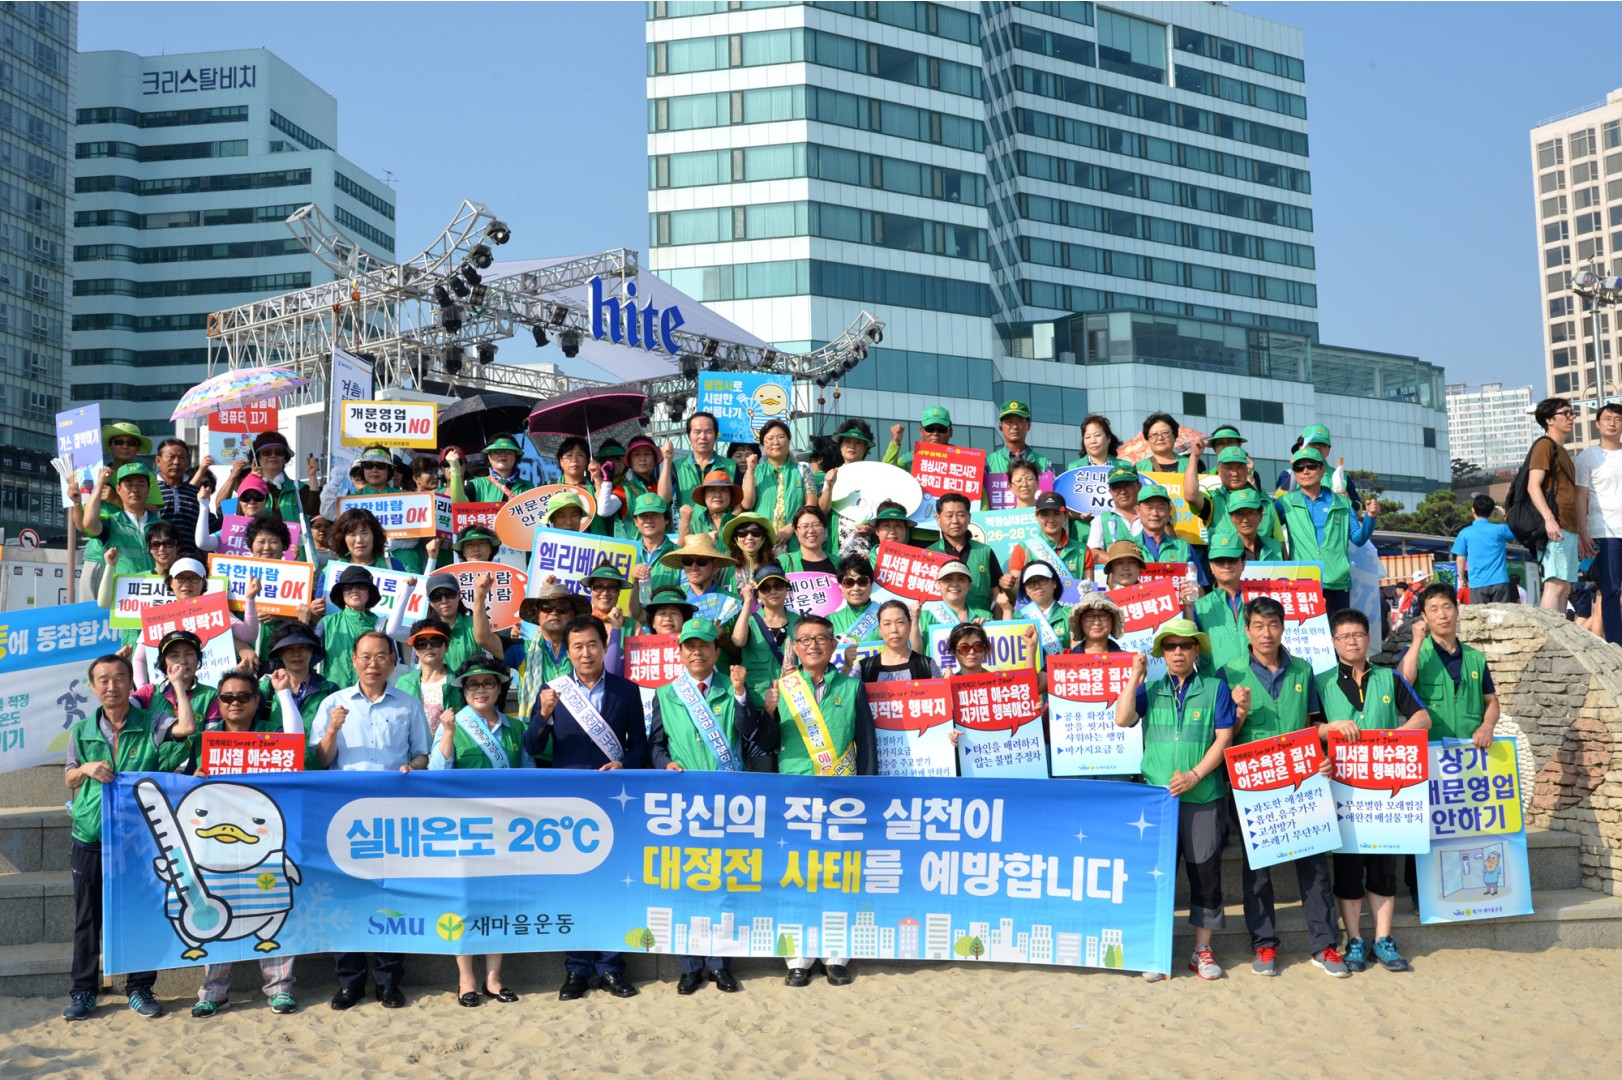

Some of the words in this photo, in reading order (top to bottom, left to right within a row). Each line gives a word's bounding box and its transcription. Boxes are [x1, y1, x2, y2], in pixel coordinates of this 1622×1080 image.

[142, 65, 256, 95] 크리스탈비치
[585, 275, 685, 356] hite
[703, 392, 733, 405] 시원한
[220, 411, 247, 424] 컴퓨터
[250, 411, 268, 425] 끄기
[350, 407, 407, 421] 개문영업
[702, 405, 743, 419] 여름나기
[364, 421, 407, 434] 안하기
[408, 418, 431, 435] NO
[59, 436, 73, 452] 가스
[73, 428, 99, 450] 절약하기
[920, 459, 948, 475] 점심시간
[949, 464, 977, 479] 퇴근시간
[1075, 470, 1107, 484] 실내
[914, 473, 941, 487] 소등하고
[943, 477, 963, 491] 플러그
[992, 490, 1015, 504] 급출
[376, 514, 403, 526] 바람
[406, 507, 428, 524] OK
[217, 563, 279, 582] 착한바람
[881, 553, 910, 573] 피서철
[911, 560, 940, 579] 해수욕
[450, 571, 512, 586] 한람
[788, 576, 831, 593] 베이터
[877, 568, 906, 587] 지키면
[907, 574, 942, 596] 행복해요
[228, 581, 278, 598] 채람
[280, 580, 305, 600] OK
[461, 588, 512, 602] 채람
[1296, 591, 1318, 604] 질서
[1128, 595, 1174, 620] 행락지
[1299, 603, 1315, 615] 꼭!
[181, 610, 225, 634] 행락지
[37, 619, 122, 653] 동참합시
[630, 648, 660, 665] 피서철
[664, 647, 681, 663] 해수
[630, 664, 660, 681] 지키면
[663, 663, 687, 680] 행복
[1053, 668, 1104, 683] 해수욕장
[1108, 667, 1133, 681] 질서
[958, 688, 989, 706] 피서철
[990, 684, 1030, 702] 해수욕장
[1054, 682, 1104, 696] 이것만은
[8, 693, 30, 708] 적정
[908, 698, 946, 718] 행락지
[960, 705, 991, 724] 지키면
[992, 700, 1036, 721] 행복해요!
[1064, 711, 1083, 721] 공용
[1087, 710, 1115, 721] 화장실
[1065, 722, 1083, 732] 발을
[973, 742, 1001, 754] 타인을
[1003, 736, 1040, 751] 배려하지
[1106, 731, 1125, 742] 행위
[209, 748, 244, 766] 피서철
[247, 749, 295, 767] 해수욕장
[1065, 745, 1112, 755] 바가지요금
[1116, 744, 1125, 754] 등
[1335, 745, 1369, 762] 피서철
[1372, 745, 1418, 762] 해수욕장
[974, 757, 993, 769] 않는
[995, 753, 1013, 766] 불법
[1015, 750, 1042, 763] 주정차
[1233, 751, 1286, 775] 해수욕장
[1290, 743, 1317, 761] 질서
[1439, 747, 1488, 775] 상가
[1238, 766, 1289, 789] 이것만은
[1293, 759, 1313, 775] 꼭!
[1335, 762, 1369, 780] 지키면
[1372, 762, 1422, 780] 행복해요!
[1252, 798, 1282, 813] 과도한
[1285, 786, 1324, 804] 애정행각
[1345, 800, 1383, 811] 무분별한
[1386, 800, 1423, 811] 모래찜질
[643, 791, 765, 839] 당신의
[783, 796, 868, 841] 작은
[883, 797, 1004, 843] 실천이
[1345, 813, 1373, 823] 애완견
[1374, 813, 1402, 823] 배설물
[1404, 813, 1423, 823] 방치
[1432, 804, 1506, 835] 안하기
[345, 817, 496, 860] 실내온도
[508, 815, 600, 854] 26°C
[1259, 820, 1297, 837] 고성방가
[1261, 833, 1290, 848] 쓰레기
[1292, 822, 1331, 840] 무단투기
[642, 846, 764, 892] 대정전
[780, 849, 903, 895] 사태를
[919, 850, 1129, 905] 예방합니다
[469, 913, 575, 936] 새마을운동
